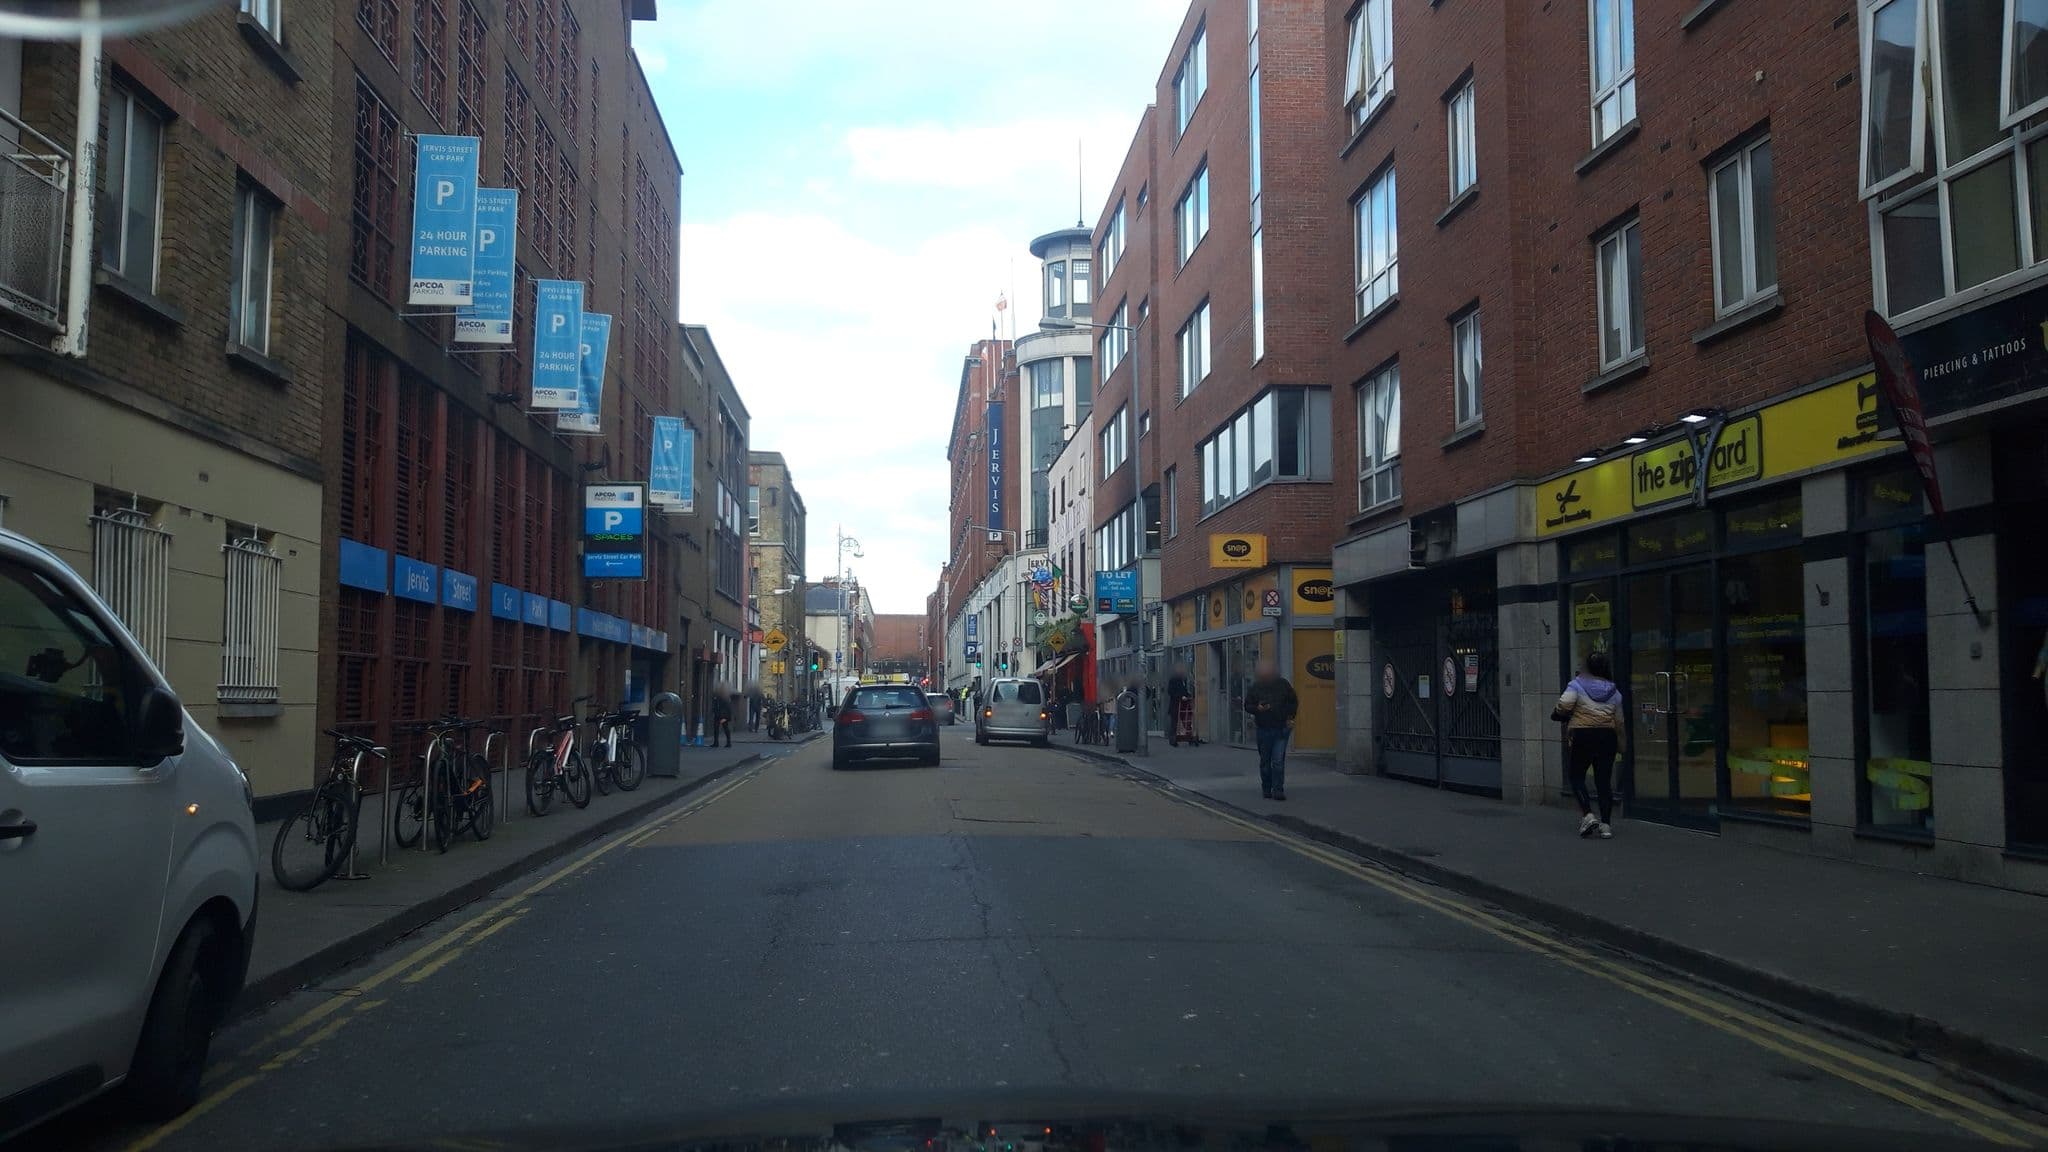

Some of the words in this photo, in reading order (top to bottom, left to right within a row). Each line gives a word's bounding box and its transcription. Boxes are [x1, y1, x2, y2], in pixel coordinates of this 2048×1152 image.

[423, 144, 447, 153] JERVIS
[448, 145, 473, 154] STREET
[446, 154, 465, 162] PARK
[437, 180, 454, 206] P
[420, 230, 433, 240] 24
[437, 231, 467, 241] HOUR
[480, 229, 496, 252] P
[420, 246, 467, 257] PARKING
[413, 281, 444, 289] APCOA
[552, 314, 565, 334] P
[540, 351, 550, 360] 24
[552, 352, 575, 360] HOUR
[1923, 355, 1967, 381] PIERCING
[1971, 353, 1979, 366] &
[1982, 337, 2027, 362] TATTOOS
[539, 362, 575, 372] PARKING
[663, 439, 673, 453] P
[991, 428, 1000, 513] JERVIS
[1638, 461, 1665, 494] the
[605, 511, 623, 531] P
[593, 533, 634, 541] SPACES
[992, 532, 999, 540] P
[1100, 571, 1113, 579] TO
[1115, 571, 1132, 579] LET
[407, 568, 430, 594] Jervis
[452, 578, 472, 603] Street
[503, 594, 514, 612] Car
[967, 645, 976, 656] P
[1312, 662, 1335, 673] sn
